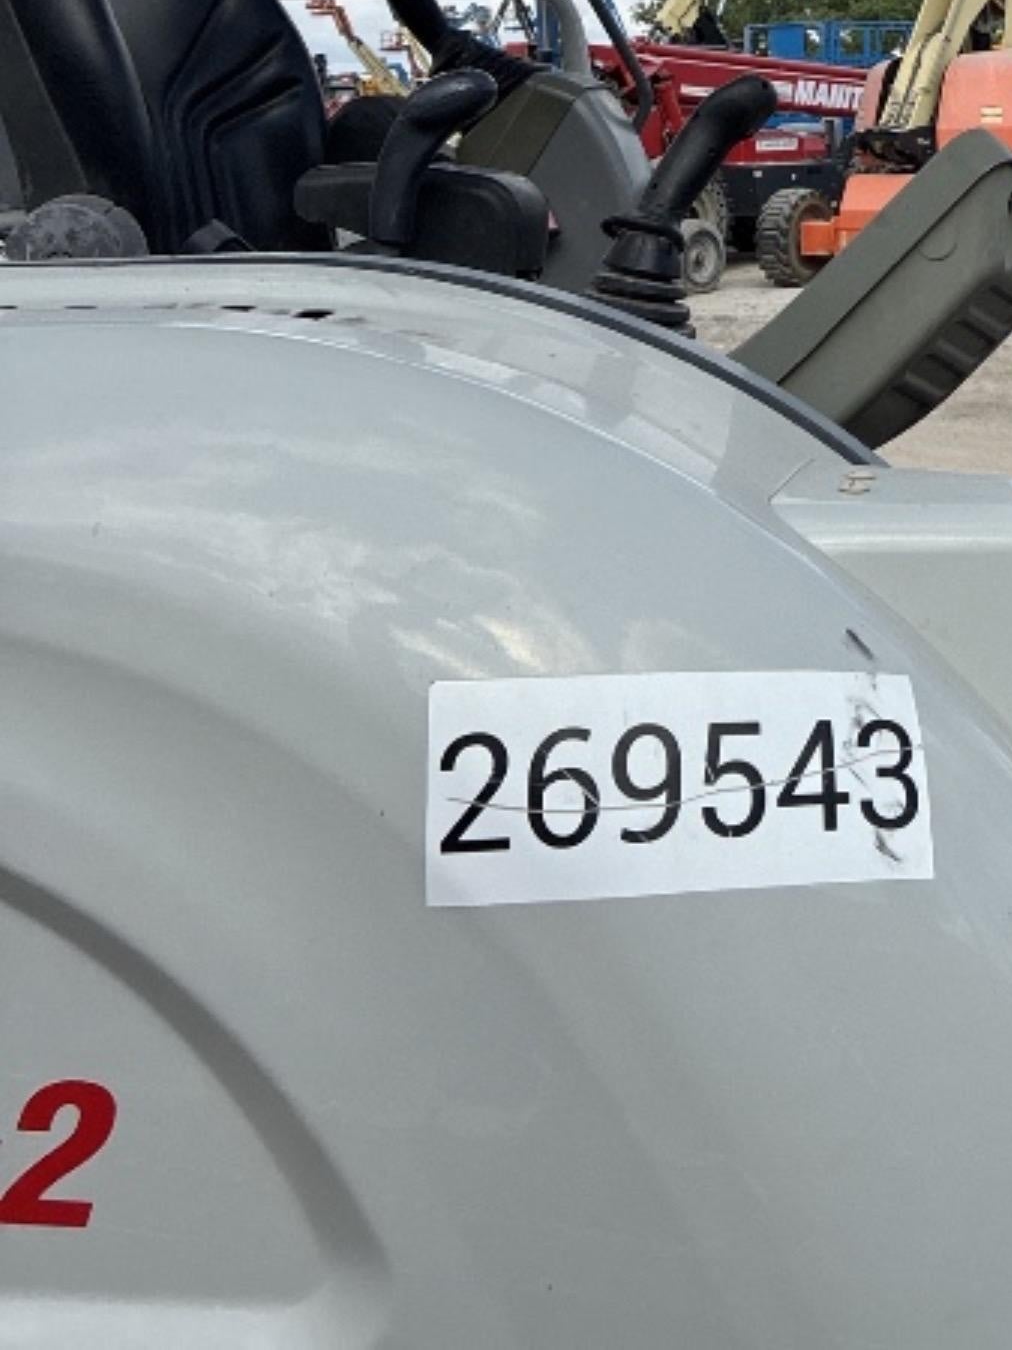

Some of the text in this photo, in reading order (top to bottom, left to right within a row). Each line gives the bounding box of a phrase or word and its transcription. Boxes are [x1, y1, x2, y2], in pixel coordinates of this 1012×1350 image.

[794, 80, 865, 110] MANIT
[439, 719, 920, 855] 269543
[0, 1079, 117, 1228] 2
